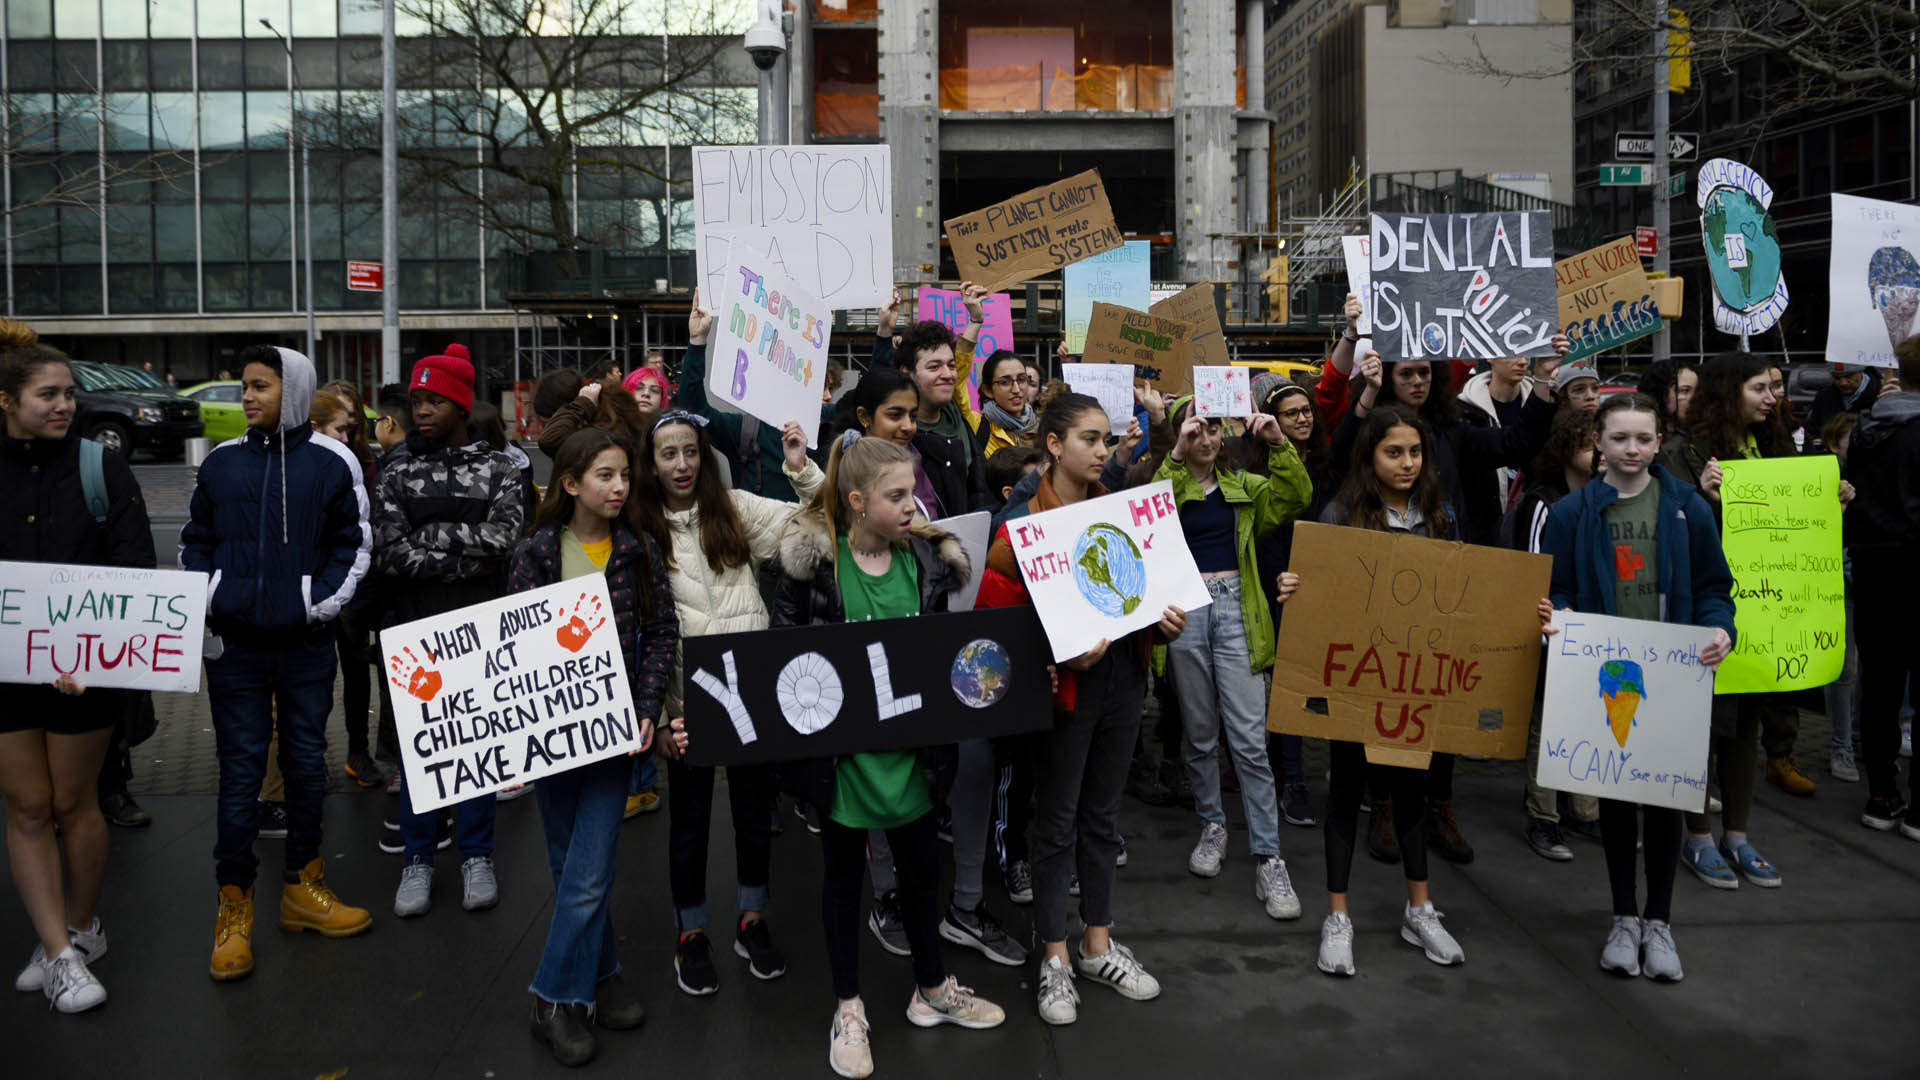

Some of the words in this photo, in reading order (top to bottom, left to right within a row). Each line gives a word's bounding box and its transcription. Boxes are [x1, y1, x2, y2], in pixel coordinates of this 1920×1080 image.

[1627, 141, 1649, 151] ONE
[1668, 141, 1686, 152] AY
[698, 148, 885, 228] EMISSION
[1620, 167, 1632, 175] AV
[985, 197, 1048, 232] PLANET
[1048, 183, 1098, 212] CANNOT
[975, 225, 1051, 268] SUSTAIN
[1048, 225, 1122, 266] SYSTEM!
[1083, 246, 1144, 265] ENIAL
[1371, 212, 1553, 273] DENIAL
[1725, 236, 1746, 262] IS
[1555, 256, 1589, 289] AISE
[739, 265, 801, 331] There
[926, 295, 995, 328] THEE
[1122, 311, 1152, 327] NEED
[1155, 317, 1187, 340] YOUR
[1400, 301, 1464, 358] NOT
[1566, 319, 1605, 354] SEA
[1604, 300, 1655, 340] LEVELS
[730, 348, 749, 401] B
[1721, 466, 1769, 501] Roses
[1772, 483, 1793, 497] are
[1802, 473, 1822, 498] red
[1128, 491, 1176, 528] HER
[1610, 520, 1657, 541] DRA
[1769, 530, 1790, 543] blue
[1021, 551, 1071, 584] WITH
[1728, 557, 1744, 573] An
[1749, 551, 1797, 573] estimated
[1357, 556, 1470, 615] YOU
[1730, 578, 1784, 602] Deaths
[1789, 583, 1811, 602] will
[0, 589, 26, 625] E
[47, 589, 134, 626] WANT
[142, 594, 188, 631] IS
[1761, 604, 1769, 612] a
[420, 622, 482, 664] WHEN
[499, 599, 552, 642] ADULTS
[1369, 624, 1443, 650] are
[1785, 630, 1808, 655] will
[1813, 631, 1839, 651] YOU
[27, 629, 184, 676] FUTURE
[484, 641, 519, 679] ACT
[1322, 642, 1482, 696] FAILING
[1561, 623, 1631, 660] Earth
[1643, 645, 1658, 663] is
[1666, 642, 1707, 682] melt
[1776, 654, 1809, 682] DO?
[421, 688, 482, 724] LIKE
[493, 650, 612, 703] CHILDREN
[413, 699, 540, 758] CHILDREN
[544, 672, 617, 718] MUST
[1374, 701, 1433, 744] US
[424, 745, 516, 800] TAKE
[523, 708, 634, 773] ACTION
[1546, 738, 1569, 759] We
